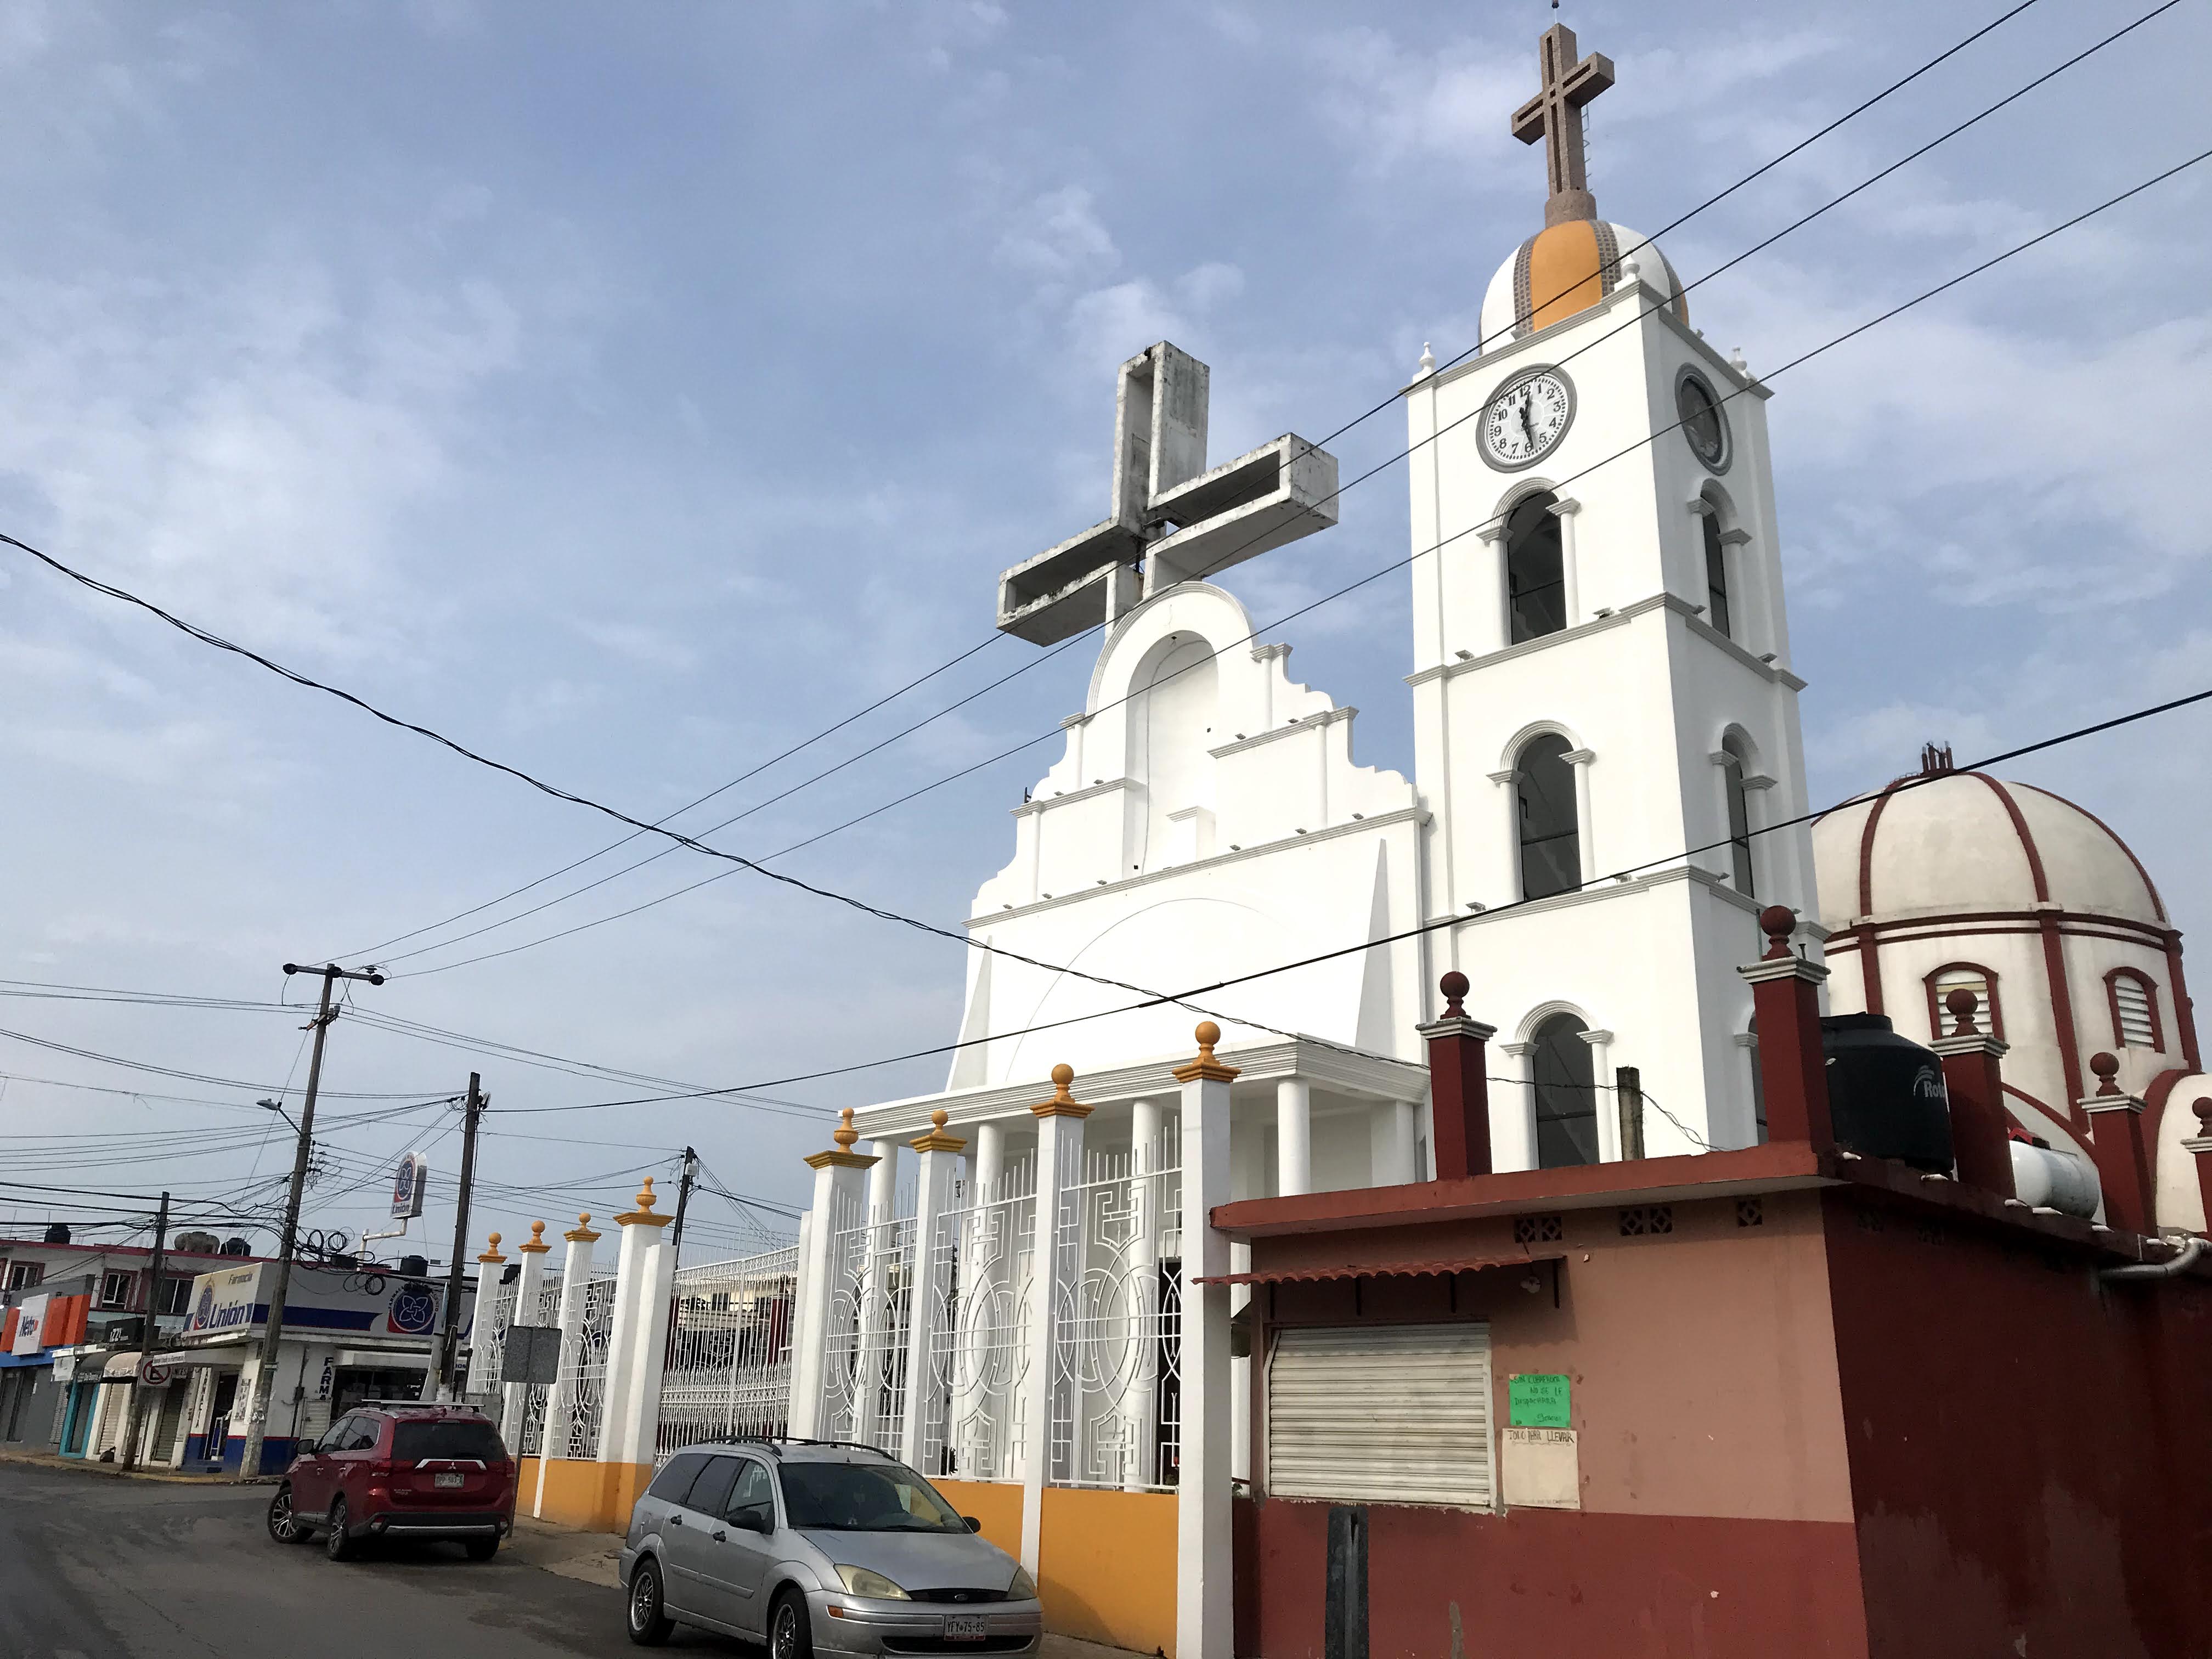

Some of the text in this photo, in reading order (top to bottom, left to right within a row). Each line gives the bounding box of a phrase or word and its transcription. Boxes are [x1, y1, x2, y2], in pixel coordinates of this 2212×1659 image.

[1520, 385, 1531, 397] 12
[1538, 383, 1542, 394] 1
[1547, 388, 1555, 400] 2
[1509, 394, 1516, 406] 11
[1553, 400, 1561, 412] 3
[1498, 408, 1508, 421] 10
[1549, 417, 1556, 428] 4
[1494, 425, 1502, 437] 9
[1539, 431, 1547, 443] 5
[1499, 438, 1507, 449] 8
[1511, 442, 1519, 454] 7
[1525, 442, 1532, 453] 6
[208, 1300, 246, 1329] Unión
[19, 1315, 36, 1338] Neto
[1547, 1431, 1575, 1443] LLEVAR
